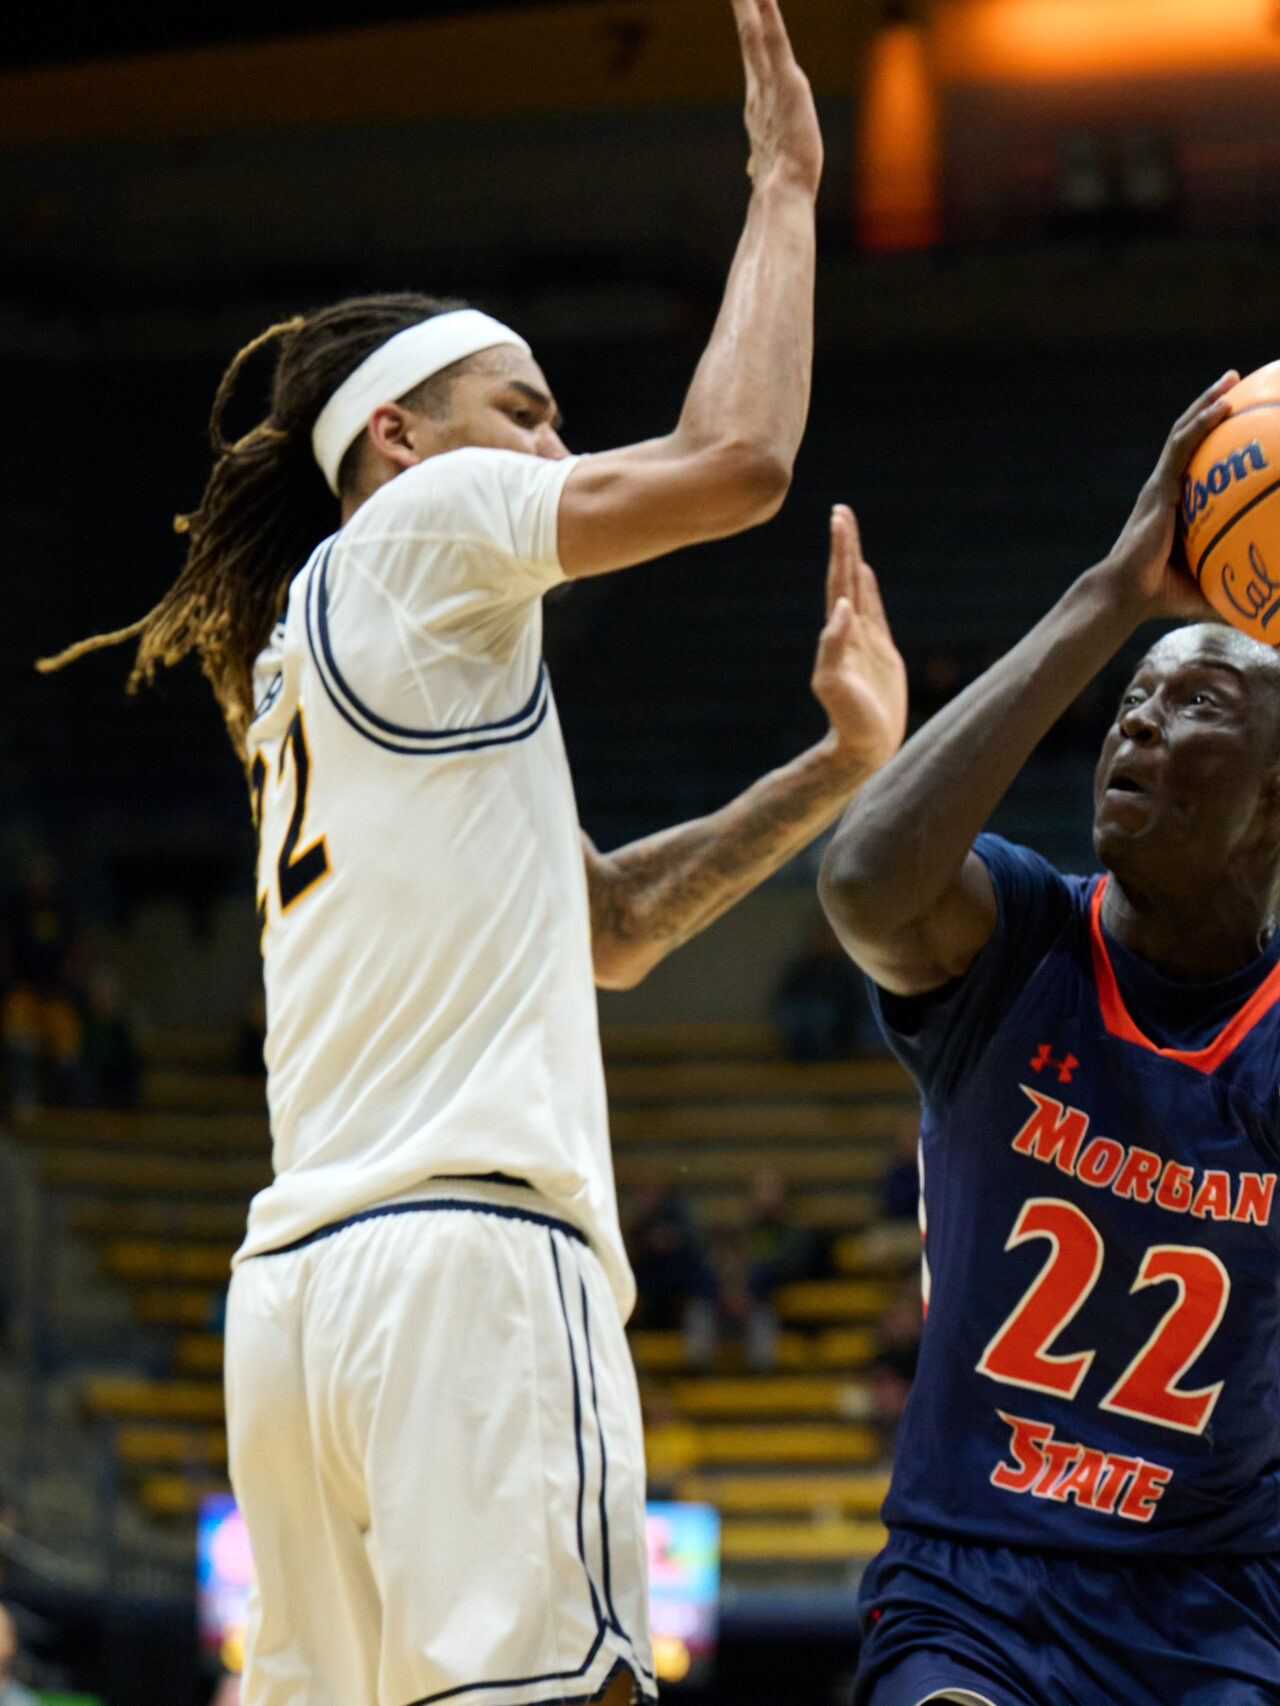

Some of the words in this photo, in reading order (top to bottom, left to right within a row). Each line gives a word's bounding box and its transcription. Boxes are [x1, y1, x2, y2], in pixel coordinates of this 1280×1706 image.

[1011, 1083, 1277, 1226] MORGAN
[975, 1197, 1231, 1436] 22
[990, 1408, 1174, 1522] STATE
